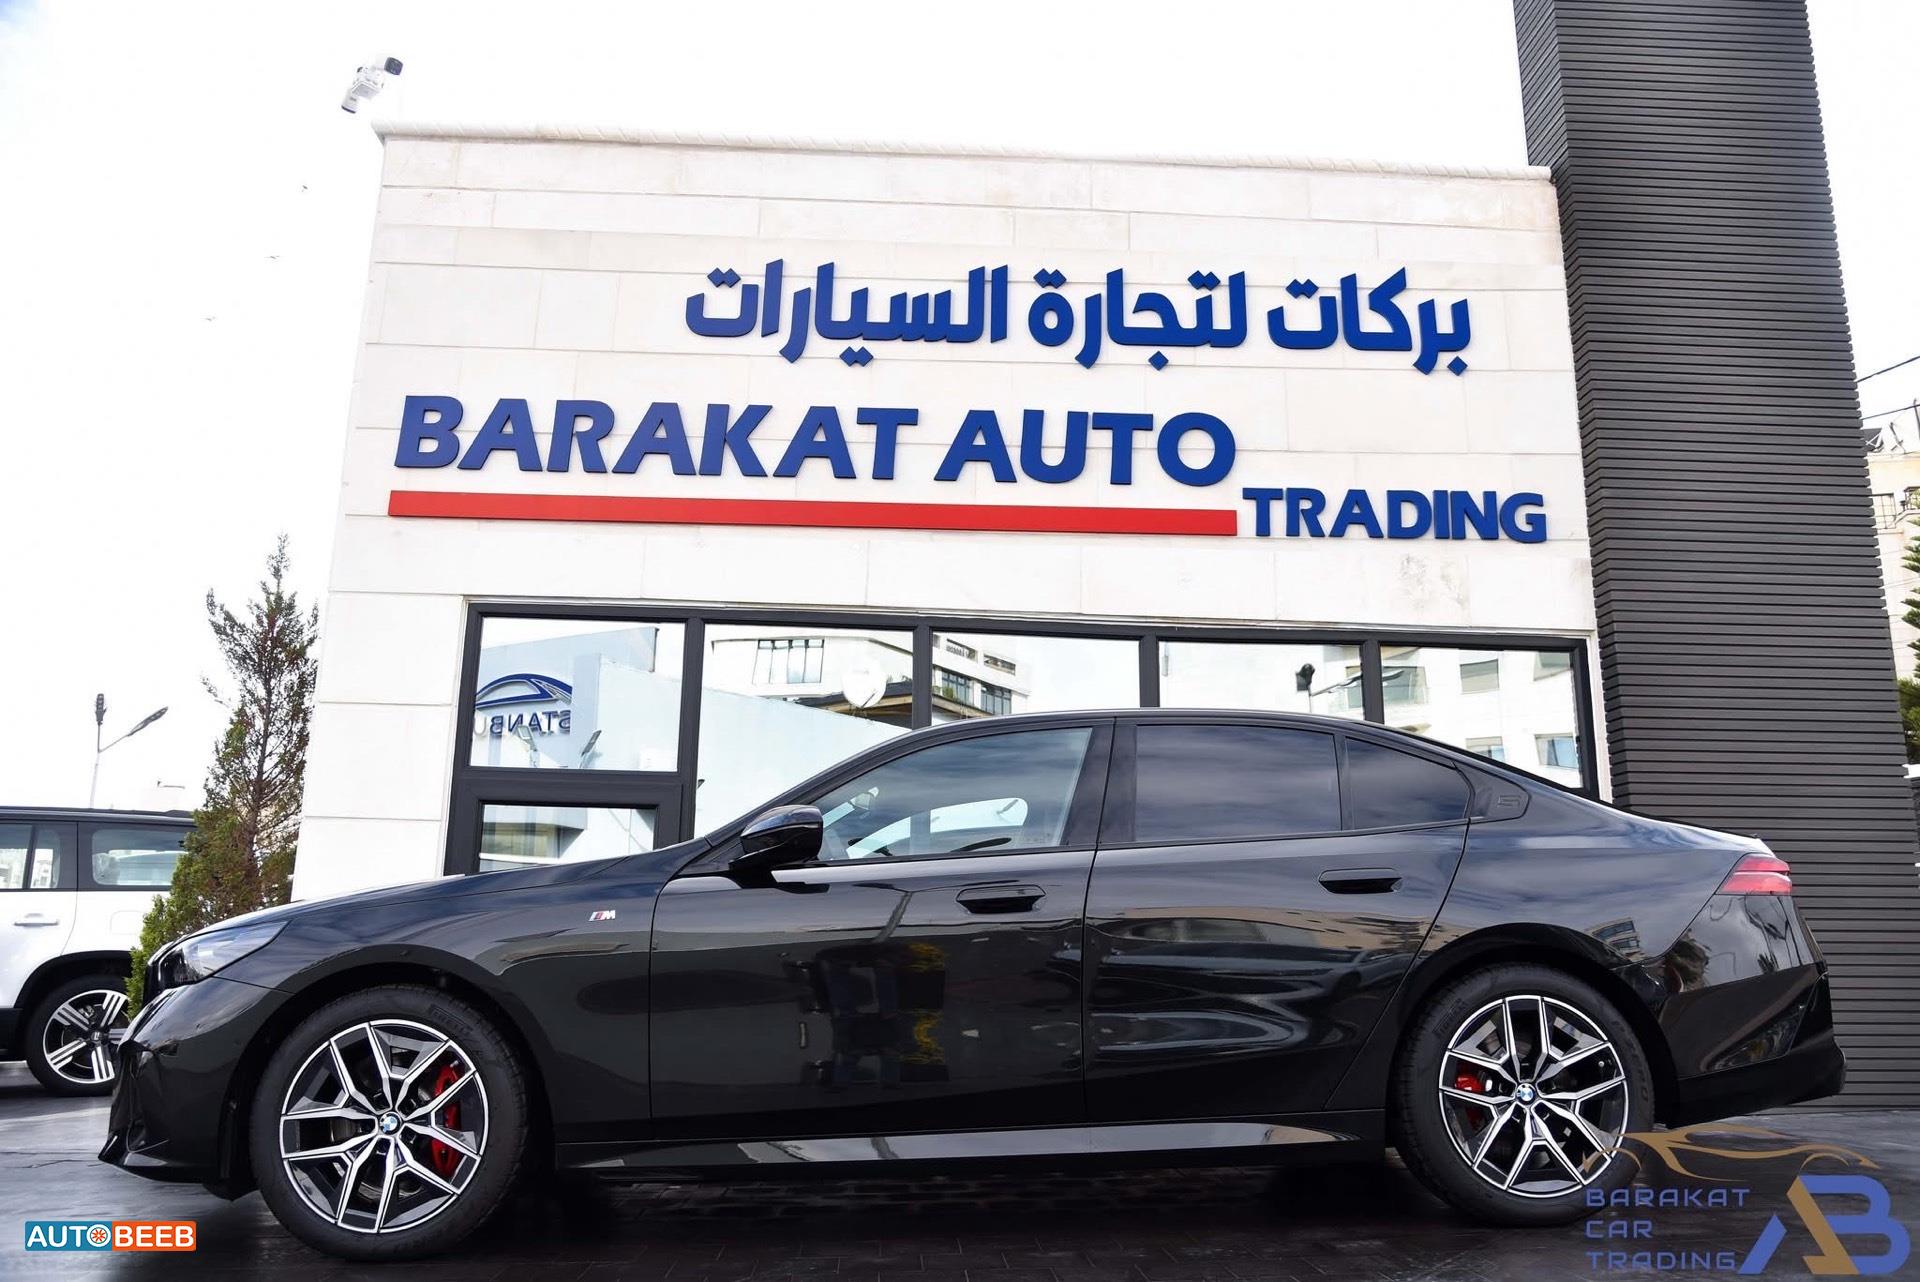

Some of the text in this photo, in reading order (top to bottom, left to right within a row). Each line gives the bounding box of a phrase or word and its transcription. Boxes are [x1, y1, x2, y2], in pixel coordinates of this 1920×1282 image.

[685, 259, 1471, 376] بركات لتجارة السيارات
[394, 395, 1237, 486] BARAKAT AUTO
[1242, 487, 1547, 543] TRADING
